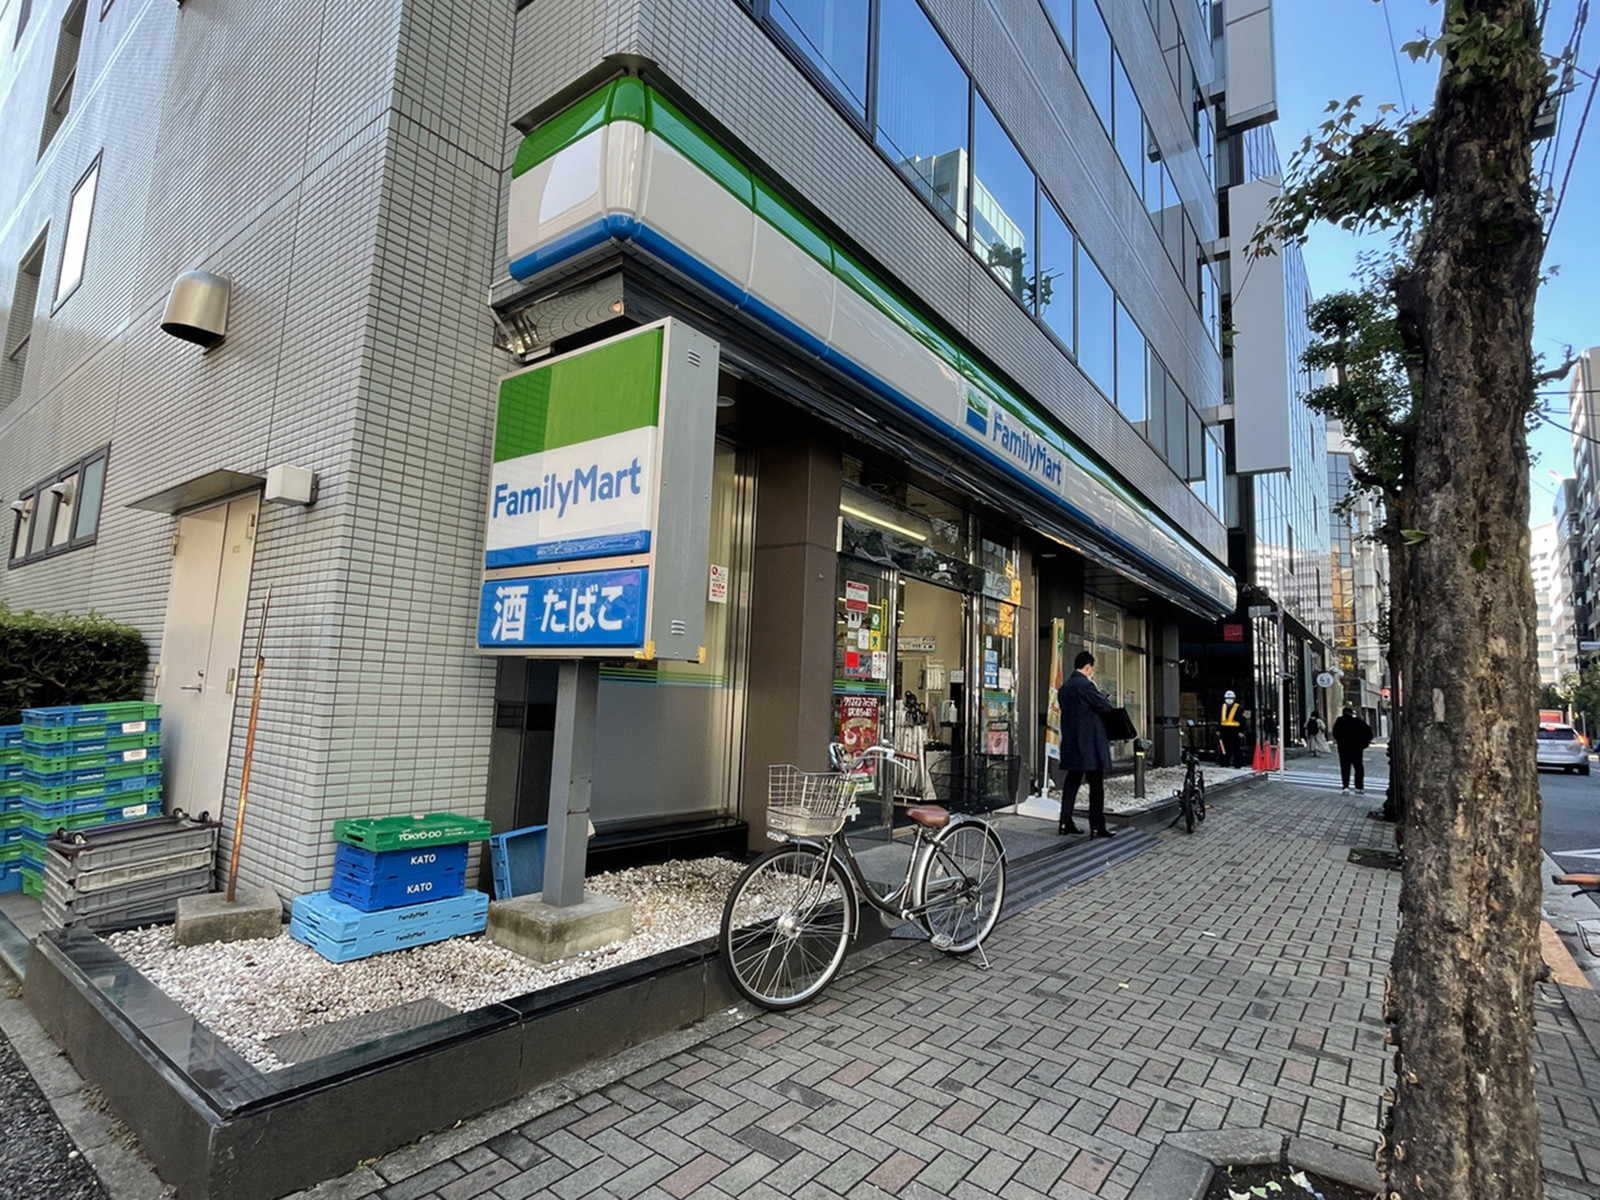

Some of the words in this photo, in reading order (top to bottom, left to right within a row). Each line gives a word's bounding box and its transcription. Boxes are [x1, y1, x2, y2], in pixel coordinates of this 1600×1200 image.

[992, 411, 1062, 486] FamilyMart
[492, 457, 642, 519] FamilyMart
[491, 585, 529, 642] 酒
[540, 583, 624, 634] たばこ
[410, 853, 437, 866] KATO
[406, 881, 433, 894] KATO
[398, 910, 429, 921] FamilyMart
[395, 931, 426, 941] FamilyMart
